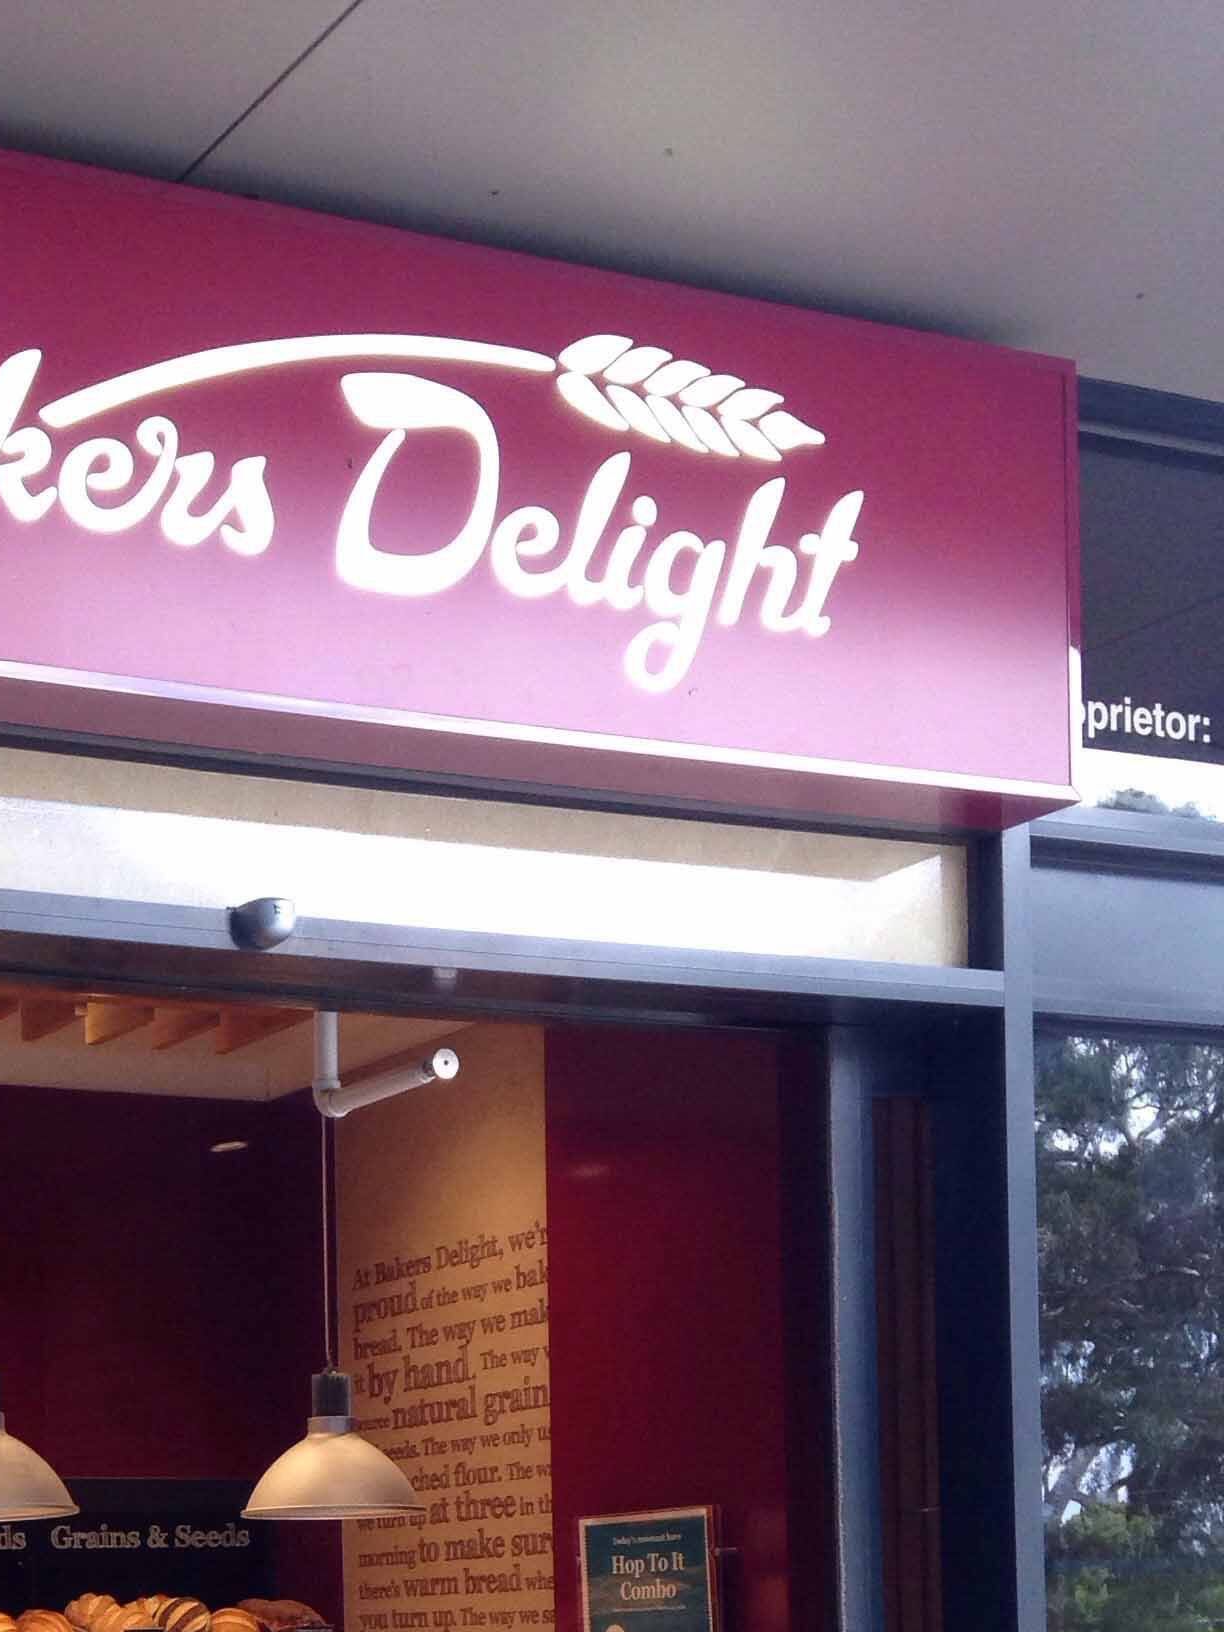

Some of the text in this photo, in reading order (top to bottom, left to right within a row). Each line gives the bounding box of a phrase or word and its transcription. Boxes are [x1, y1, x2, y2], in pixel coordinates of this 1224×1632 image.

[335, 371, 865, 695] Delight
[1082, 697, 1211, 744] prietor:
[374, 1256, 432, 1286] Bakers
[435, 1233, 504, 1270] Delight,
[353, 1280, 417, 1333] proud
[436, 1288, 459, 1305] the
[461, 1283, 488, 1304] way
[492, 1279, 512, 1293] we
[353, 1328, 402, 1360] bread.
[407, 1325, 439, 1349] The
[443, 1319, 476, 1346] way
[480, 1313, 506, 1335] we
[368, 1362, 398, 1405] by
[403, 1344, 476, 1392] hand.
[480, 1350, 507, 1370] The
[510, 1346, 539, 1367] way
[392, 1385, 477, 1430] natural
[422, 1437, 448, 1456] The
[451, 1434, 477, 1455] way
[481, 1432, 500, 1447] we
[503, 1424, 532, 1447] only
[454, 1462, 502, 1487] flour.
[506, 1462, 533, 1482] The
[429, 1499, 450, 1525] at
[454, 1490, 517, 1522] three
[520, 1498, 534, 1516] in
[50, 1523, 250, 1550] Grains & Seeds
[358, 1546, 417, 1569] morning
[418, 1537, 440, 1563] to
[444, 1528, 505, 1561] make
[359, 1580, 401, 1600] there's
[403, 1575, 459, 1598] warm
[463, 1563, 522, 1596] bread
[612, 1551, 686, 1578] Hop To It
[621, 1578, 677, 1600] Combo
[392, 1609, 429, 1629] turn
[432, 1608, 457, 1632] up.
[460, 1607, 486, 1626] The
[489, 1611, 516, 1629] way
[520, 1609, 540, 1623] we
